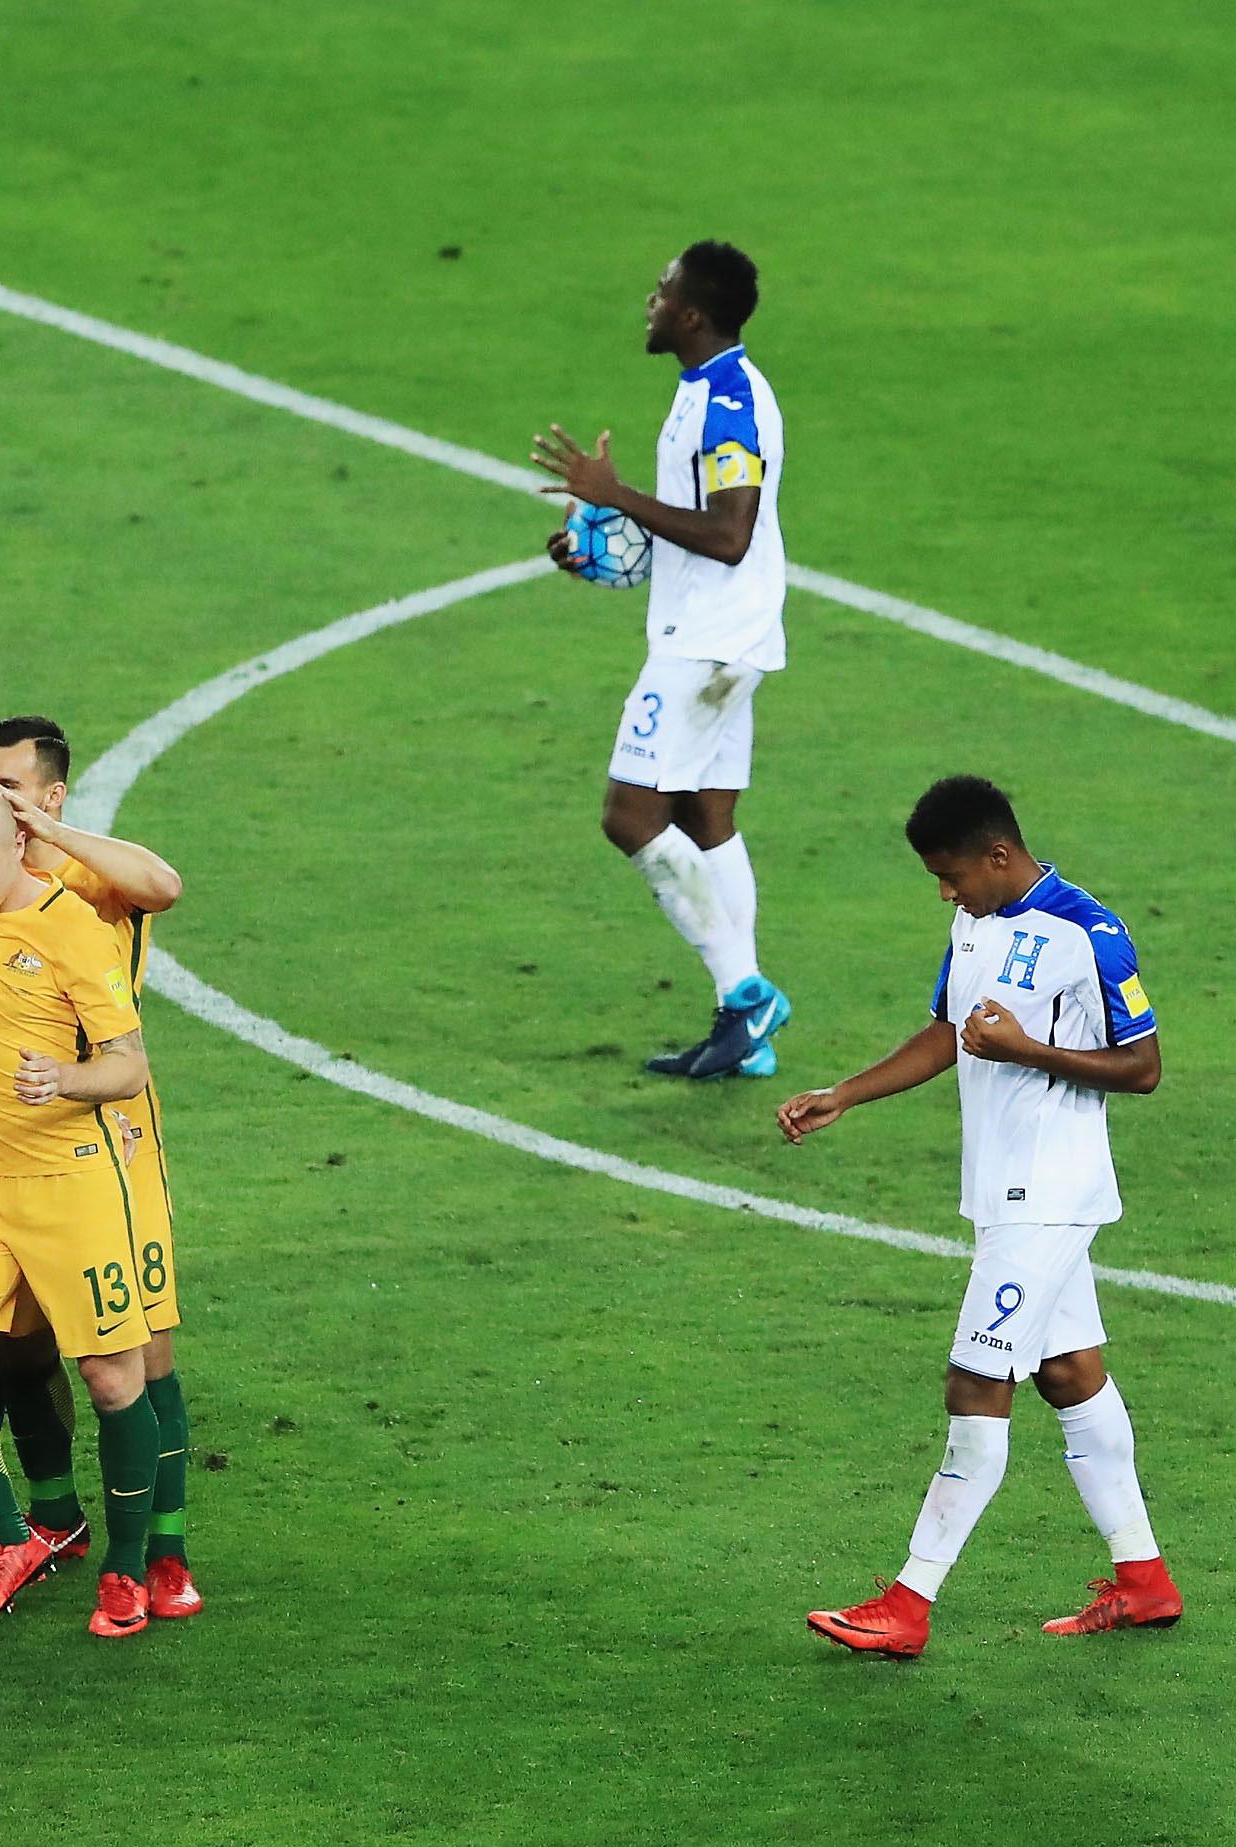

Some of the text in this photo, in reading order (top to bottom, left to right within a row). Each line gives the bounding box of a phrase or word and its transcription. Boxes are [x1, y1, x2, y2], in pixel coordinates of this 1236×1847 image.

[632, 691, 663, 738] 3
[997, 930, 1050, 991] H
[83, 1261, 130, 1318] 13
[142, 1241, 166, 1293] 8
[986, 1281, 1025, 1331] 9
[970, 1330, 1013, 1352] Joma
